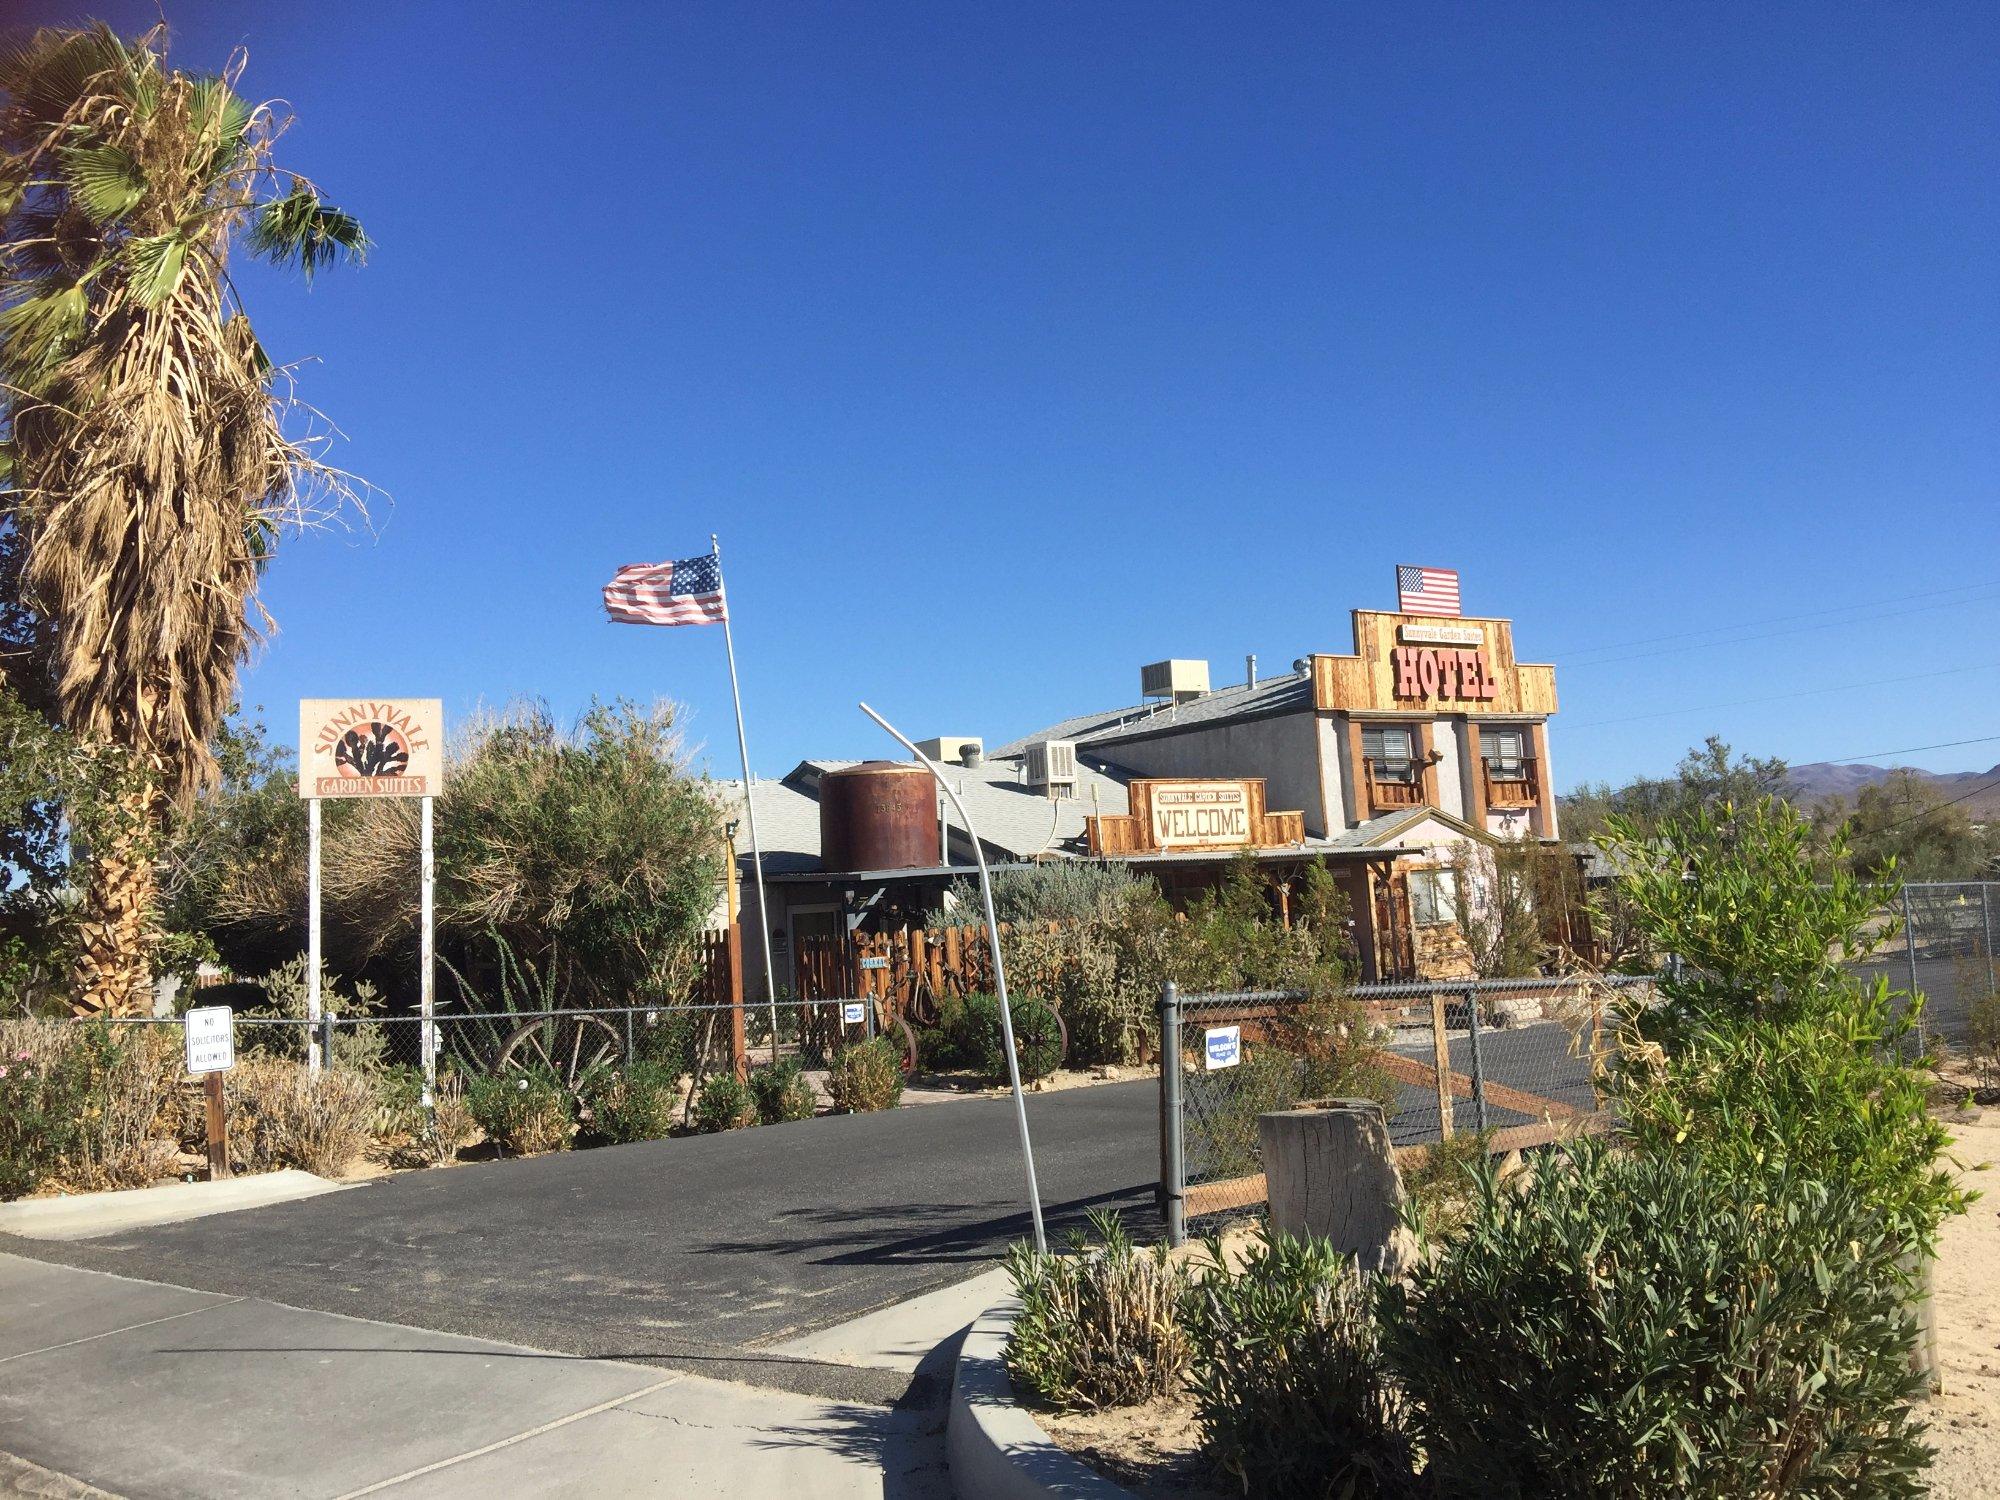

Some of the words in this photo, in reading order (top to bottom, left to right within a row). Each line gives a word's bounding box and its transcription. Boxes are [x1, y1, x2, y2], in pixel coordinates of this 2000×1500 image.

[1396, 648, 1498, 698] HOTEL
[314, 702, 430, 756] SUNNYVALE
[320, 777, 374, 794] GARDEN
[378, 777, 421, 793] SUITES
[1157, 808, 1246, 838] WELCOME
[204, 1018, 214, 1027] NO
[191, 1033, 230, 1046] SOLICITORS
[195, 1051, 227, 1063] ALLOWED
